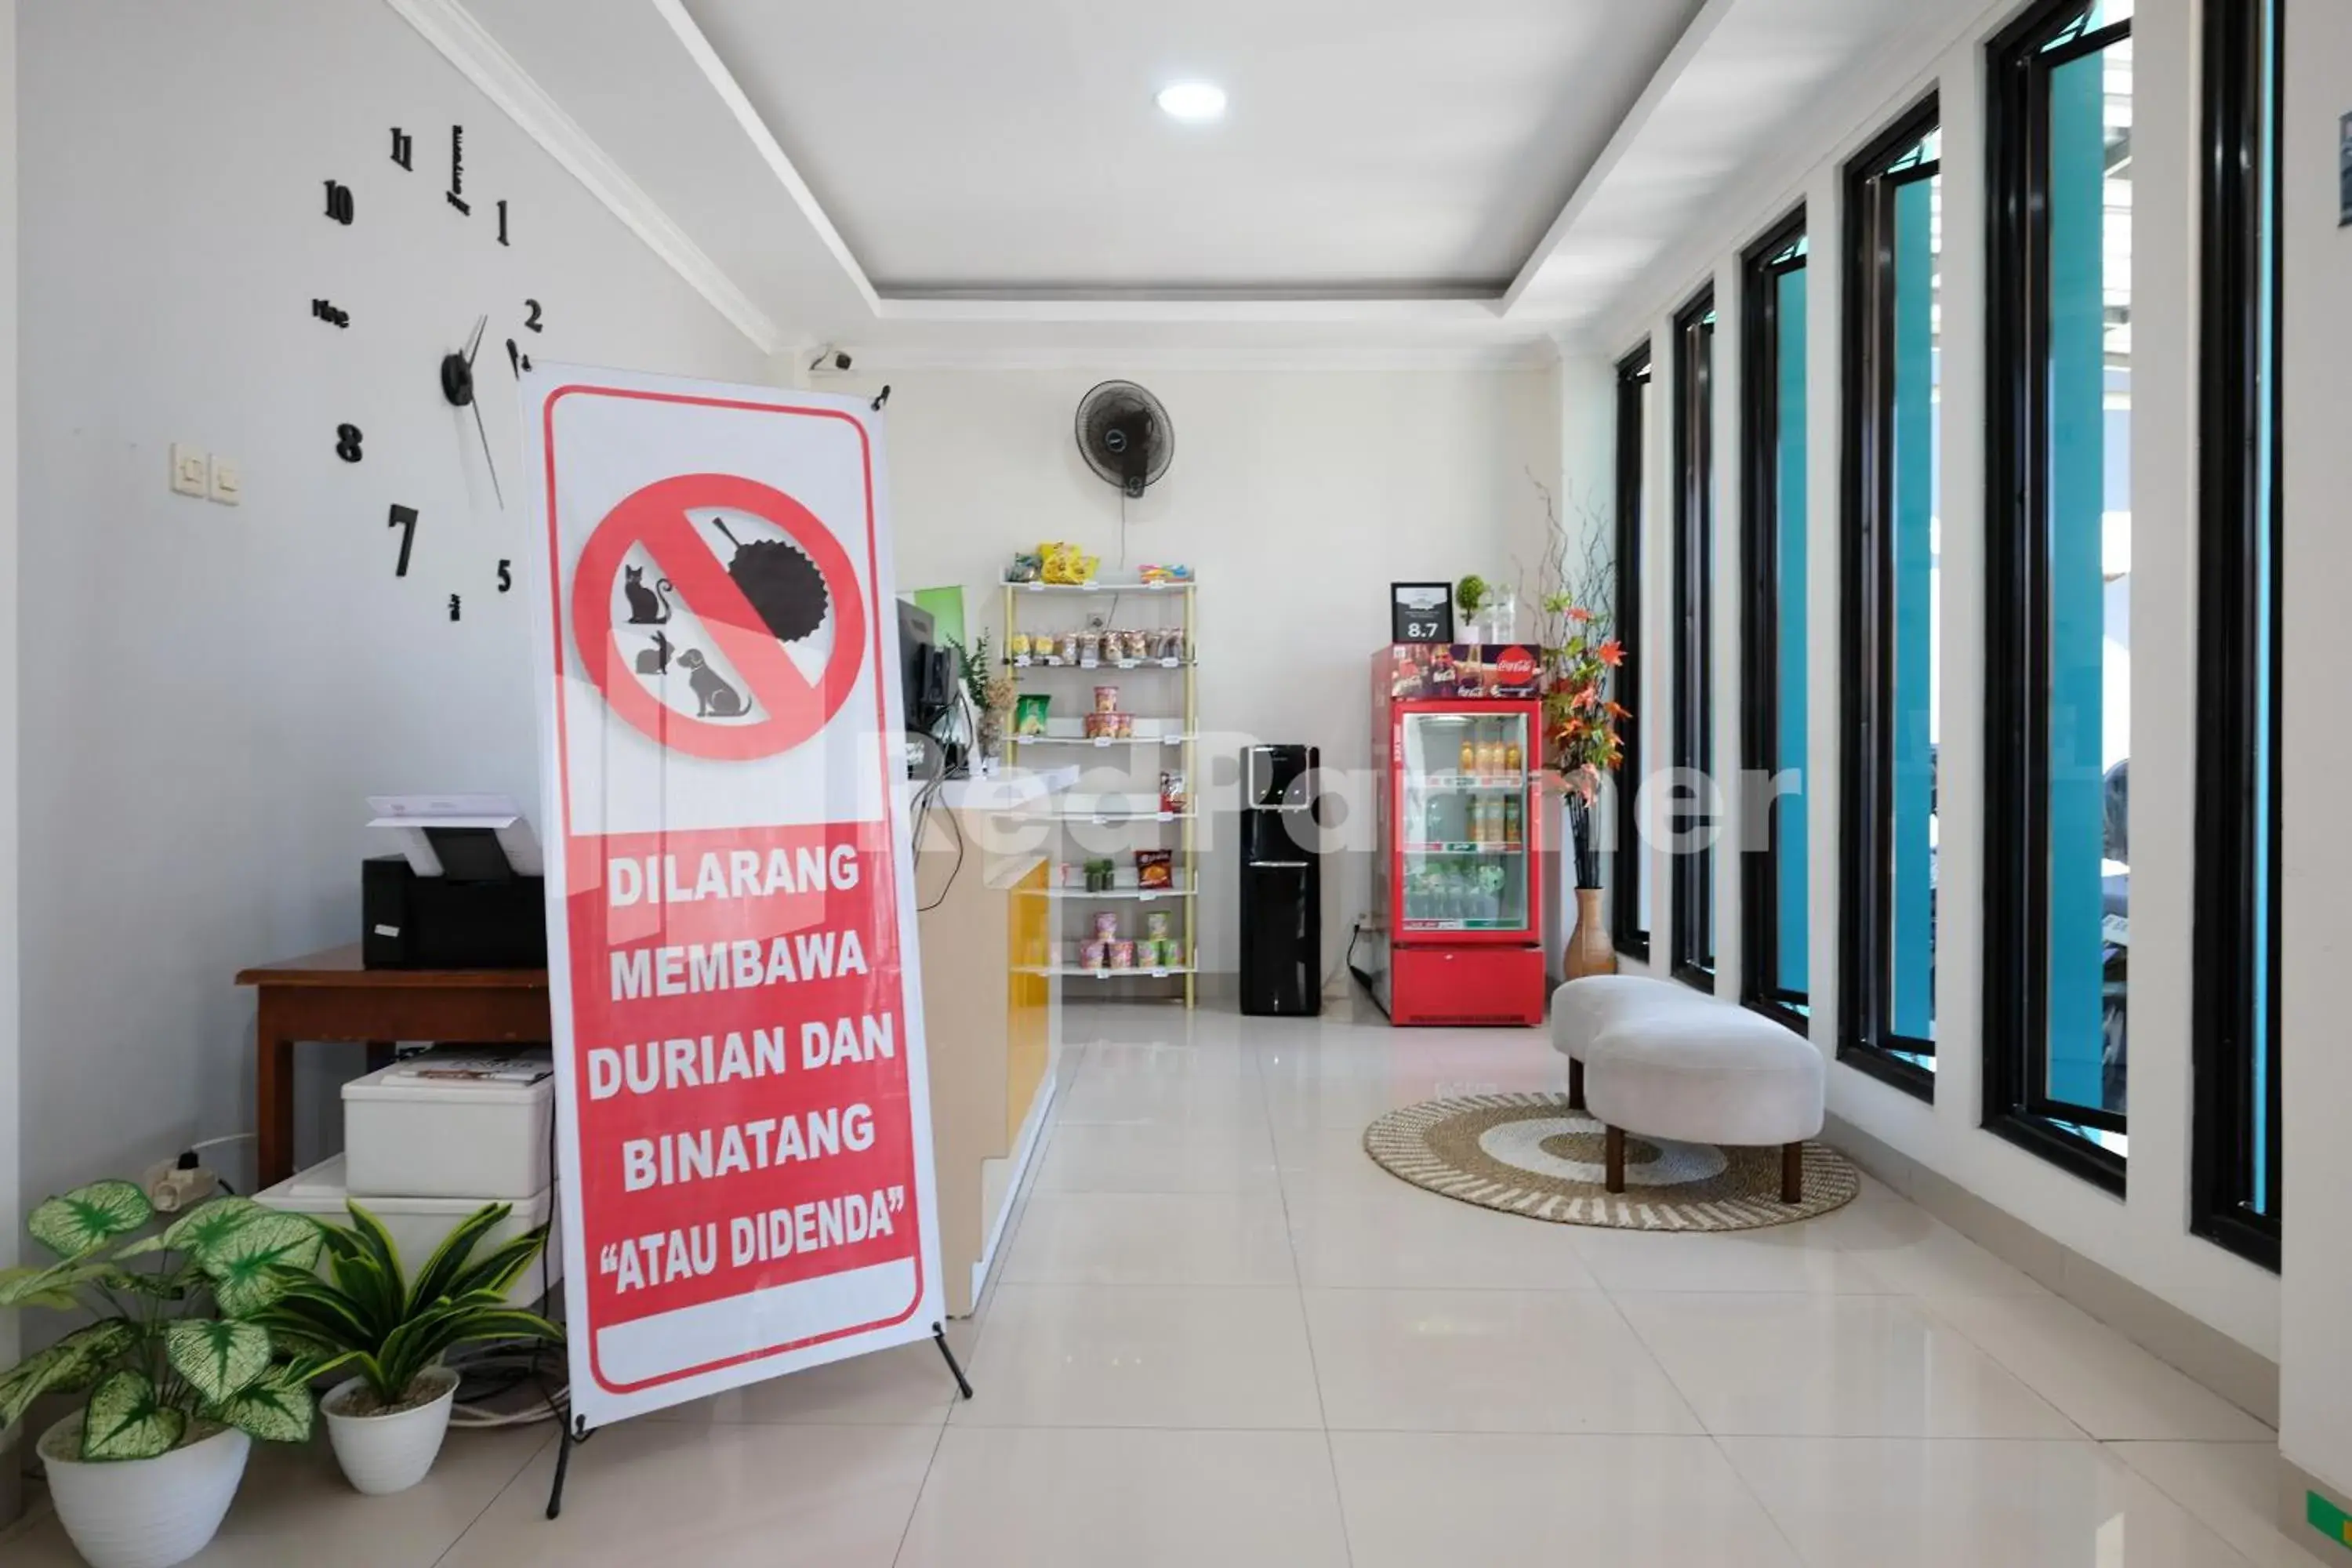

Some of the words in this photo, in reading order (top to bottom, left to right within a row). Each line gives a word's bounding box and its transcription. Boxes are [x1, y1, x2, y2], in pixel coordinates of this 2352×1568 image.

[323, 180, 354, 226] 10
[524, 299, 543, 333] 2
[336, 423, 363, 463] 8
[388, 503, 419, 577] 7
[497, 559, 511, 593] 5
[1408, 622, 1439, 637] 8.7
[608, 844, 858, 907] DILARANG
[610, 930, 868, 1001] MEMBAWA
[588, 1027, 785, 1099] DURIAN
[802, 1012, 895, 1069] DAN
[622, 1104, 874, 1192] BINATANG
[601, 1224, 717, 1294] “ATAU
[731, 1185, 904, 1267] DIDENDA”
